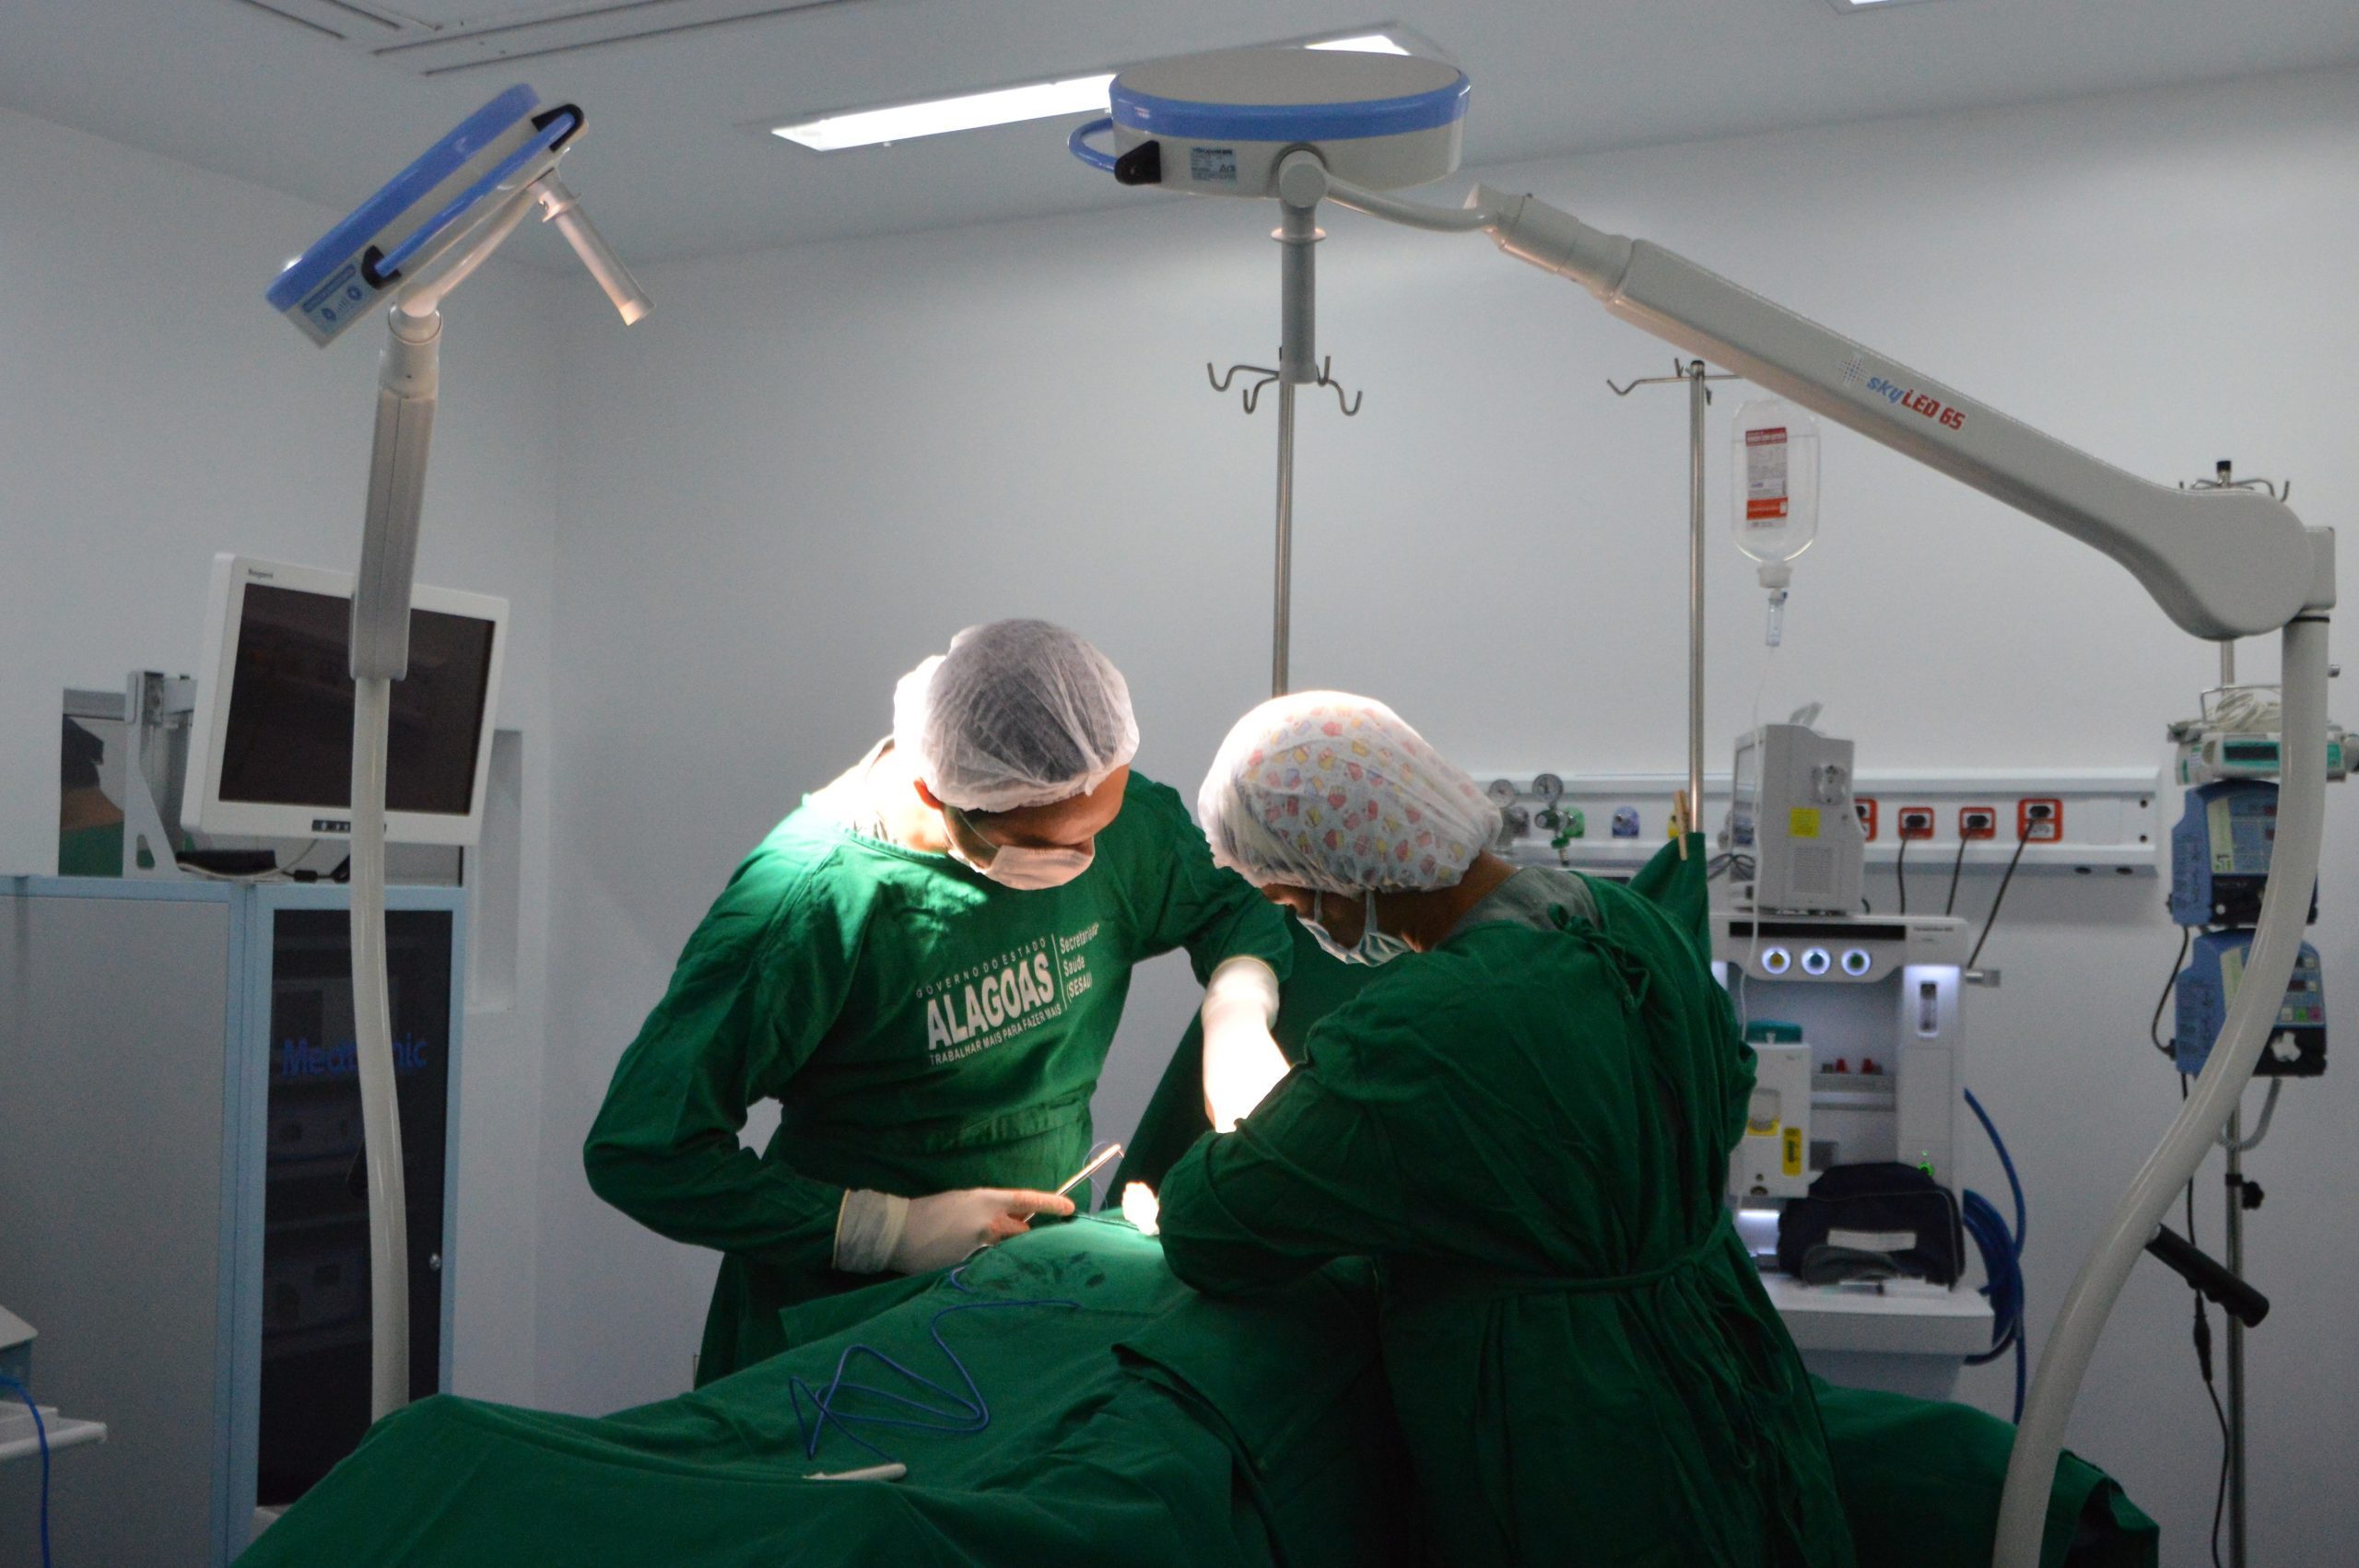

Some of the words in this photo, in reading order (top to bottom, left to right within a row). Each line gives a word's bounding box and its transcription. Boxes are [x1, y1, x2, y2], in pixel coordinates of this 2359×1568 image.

[1866, 376, 1941, 418] skyLED
[1938, 406, 1966, 430] 65
[916, 966, 979, 999] GOVERNO
[982, 959, 998, 973] DO
[1002, 937, 1046, 965] ESTADO
[927, 952, 1054, 1050] ALAGOAS
[930, 1039, 982, 1066] TRABALHAR
[982, 1032, 1003, 1049] MAIS
[1002, 1022, 1024, 1040] PARA
[1022, 1012, 1046, 1031] FAZER
